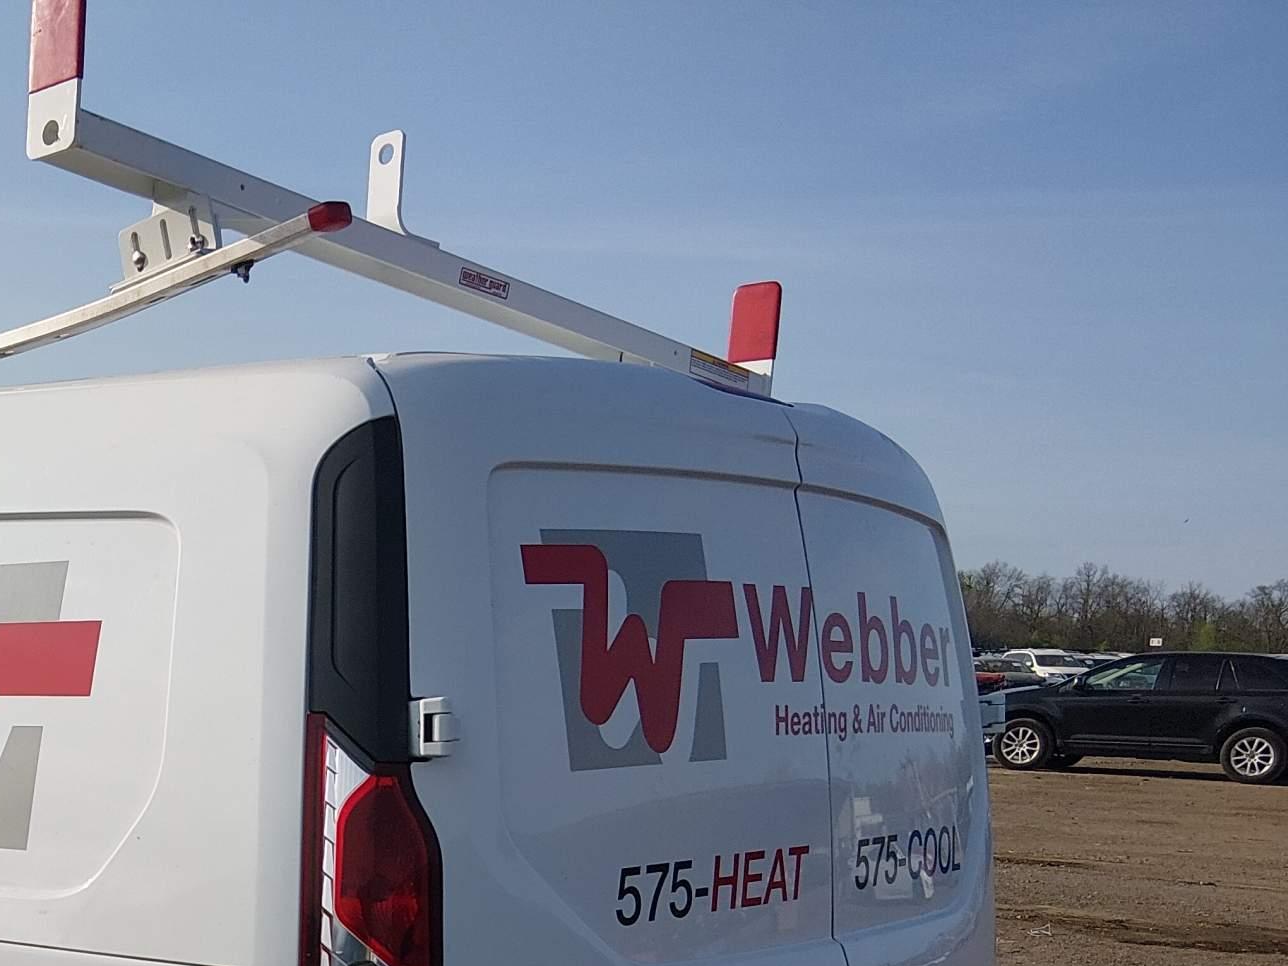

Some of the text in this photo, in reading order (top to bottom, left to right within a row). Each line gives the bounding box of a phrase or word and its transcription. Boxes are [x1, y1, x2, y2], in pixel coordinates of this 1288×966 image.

[742, 583, 951, 687] Webber
[775, 704, 954, 742] Heating & Air Conditioning
[615, 845, 810, 927] 575-HEAT
[855, 826, 961, 890] 575-COOL
